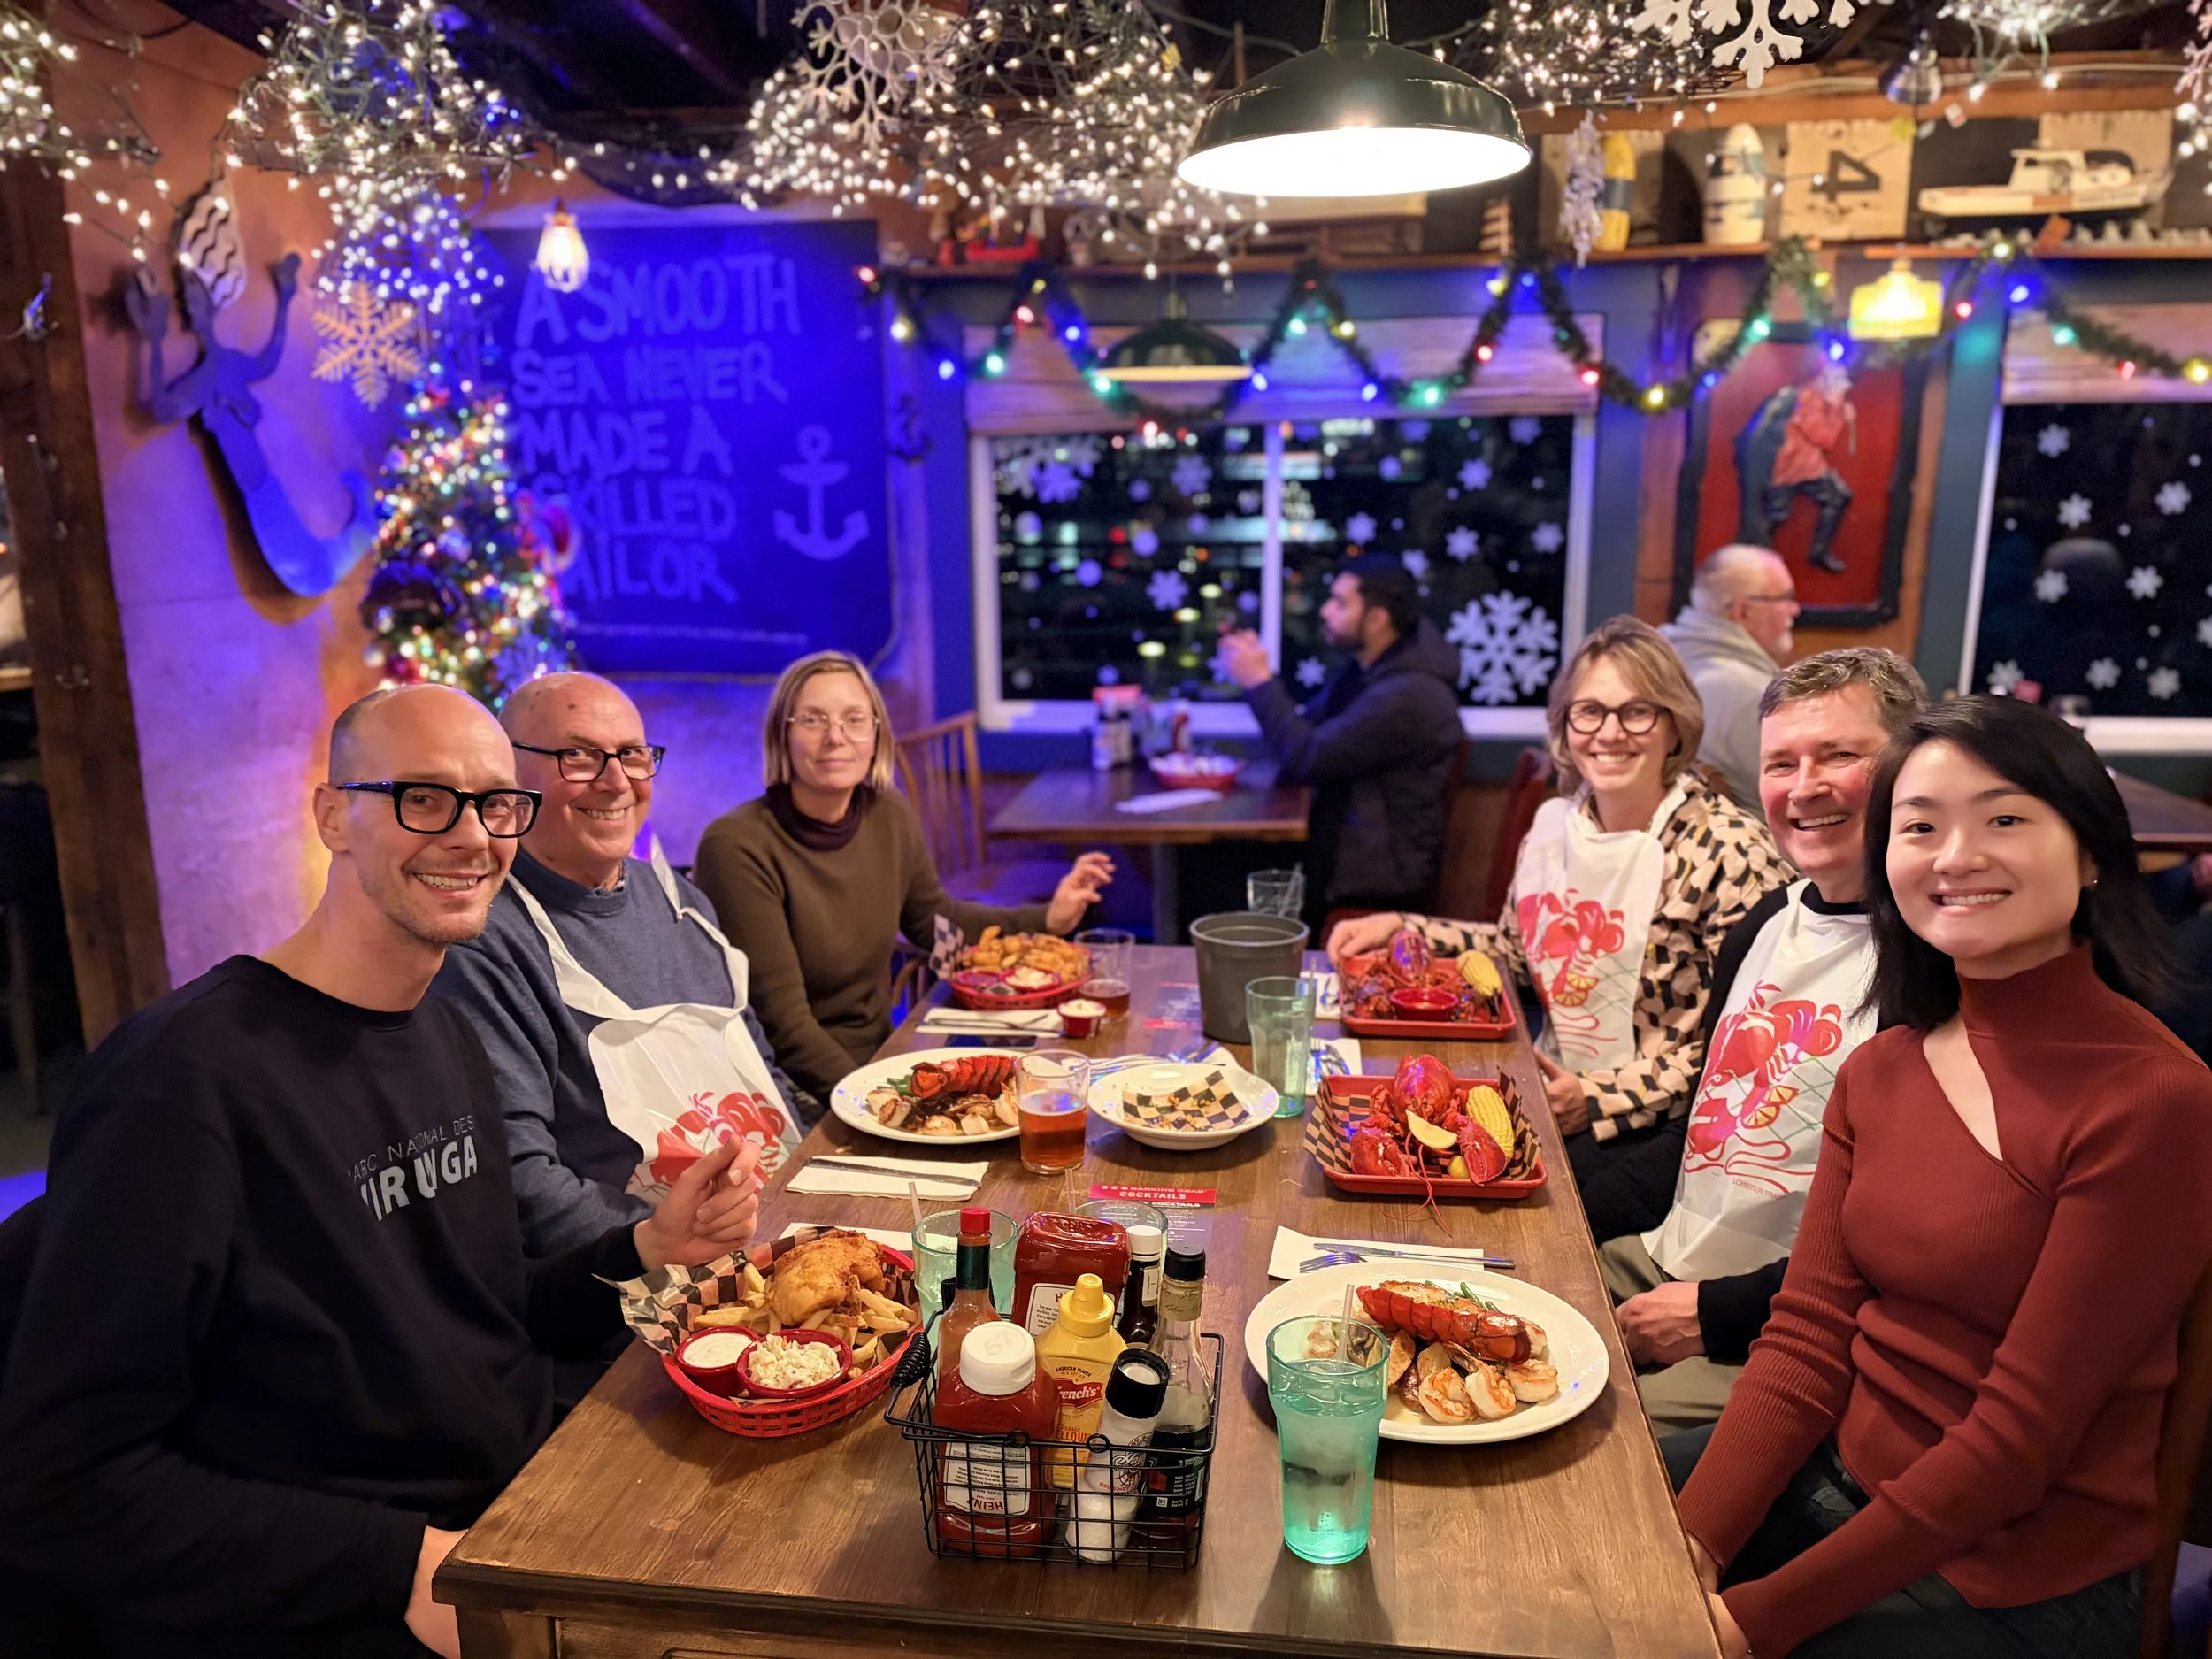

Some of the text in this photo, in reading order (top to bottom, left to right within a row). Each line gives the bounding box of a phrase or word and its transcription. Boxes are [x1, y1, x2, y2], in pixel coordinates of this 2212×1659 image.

[1811, 150, 1881, 203] 4
[514, 254, 801, 348] A SMOOTH
[511, 341, 789, 409] SEA NEVER
[518, 403, 735, 476] MADE A
[559, 539, 740, 605] AILOR
[347, 1153, 378, 1184] ARC
[453, 1115, 474, 1136] DES
[1118, 1191, 1187, 1200] COCKTAILS
[1057, 1386, 1097, 1400] ench's
[971, 1497, 1004, 1511] HEIN
